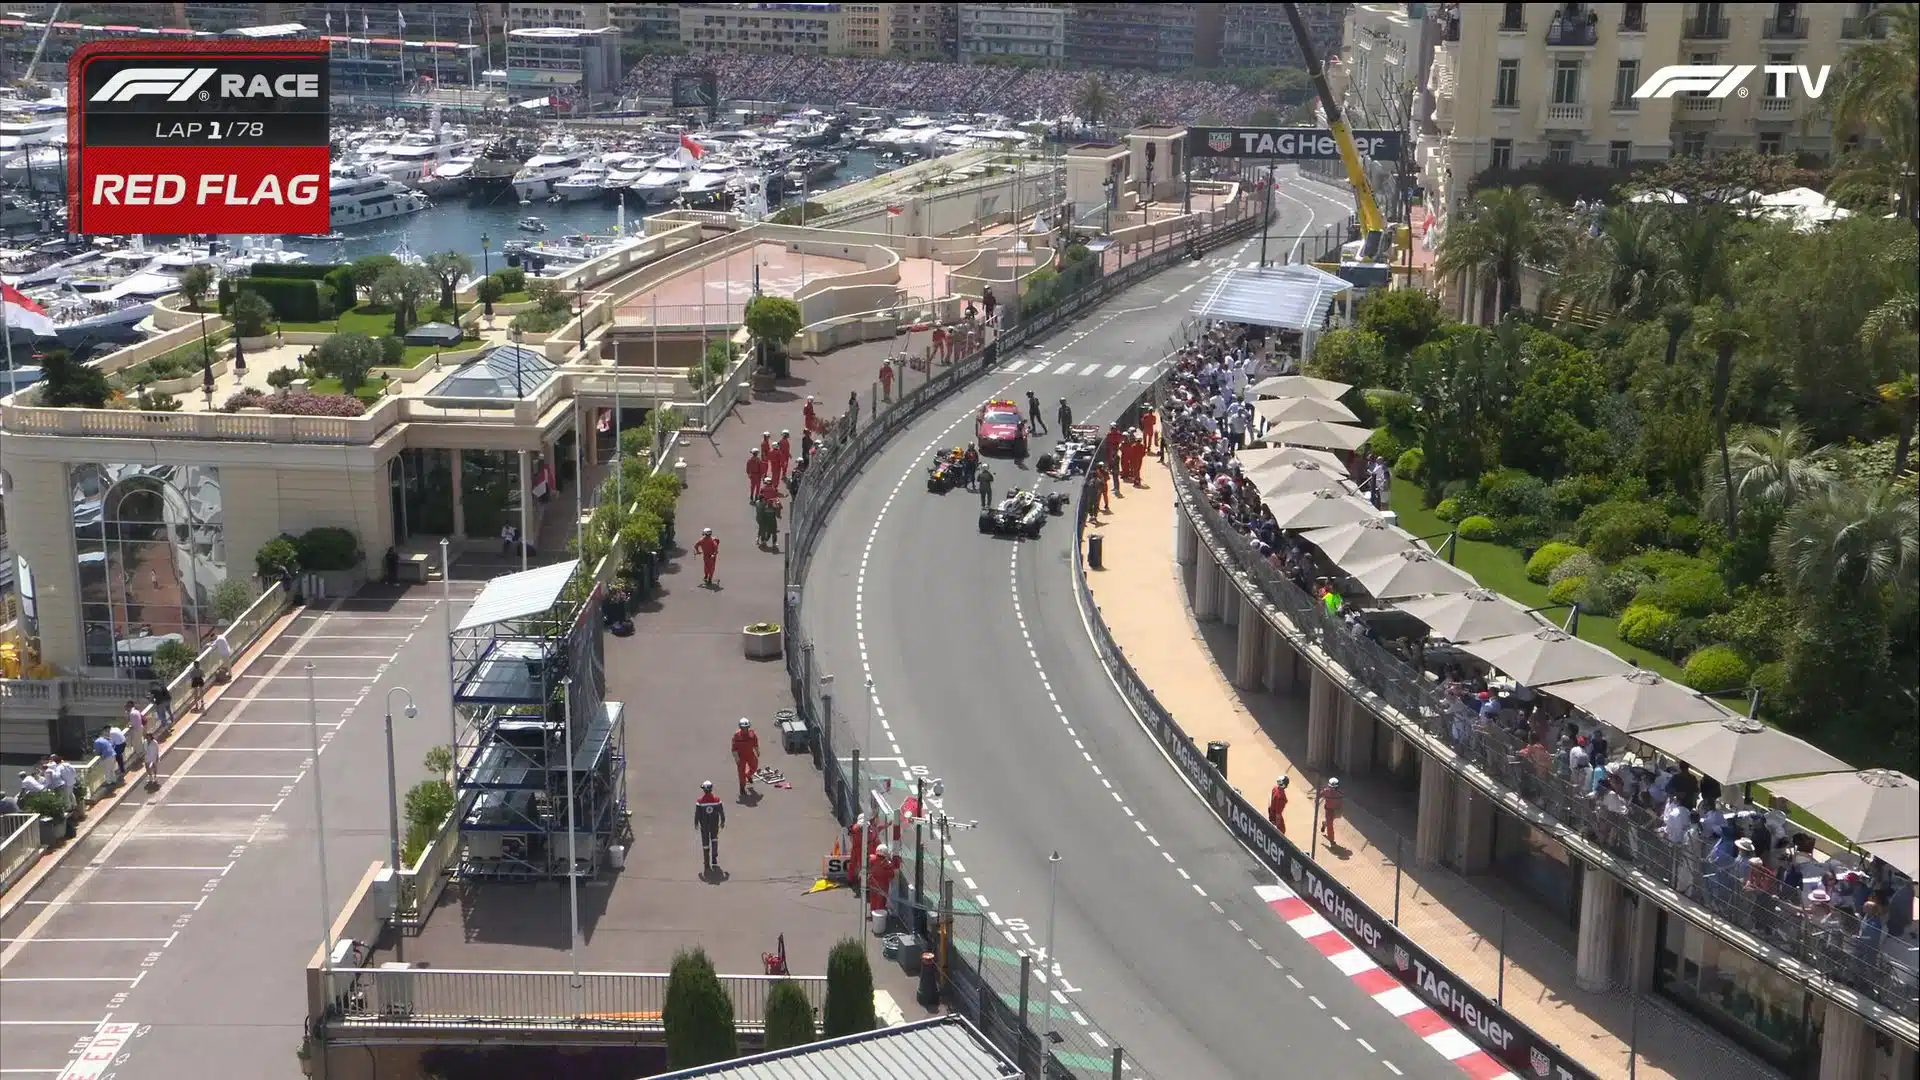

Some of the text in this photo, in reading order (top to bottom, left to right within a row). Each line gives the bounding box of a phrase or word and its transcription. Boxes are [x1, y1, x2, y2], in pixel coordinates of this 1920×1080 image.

[1240, 132, 1384, 156] TAGHeer
[1225, 796, 1285, 865] TAGHeuer
[1305, 869, 1382, 949] TAGHeuer
[1413, 959, 1514, 1050] TAGHeuer
